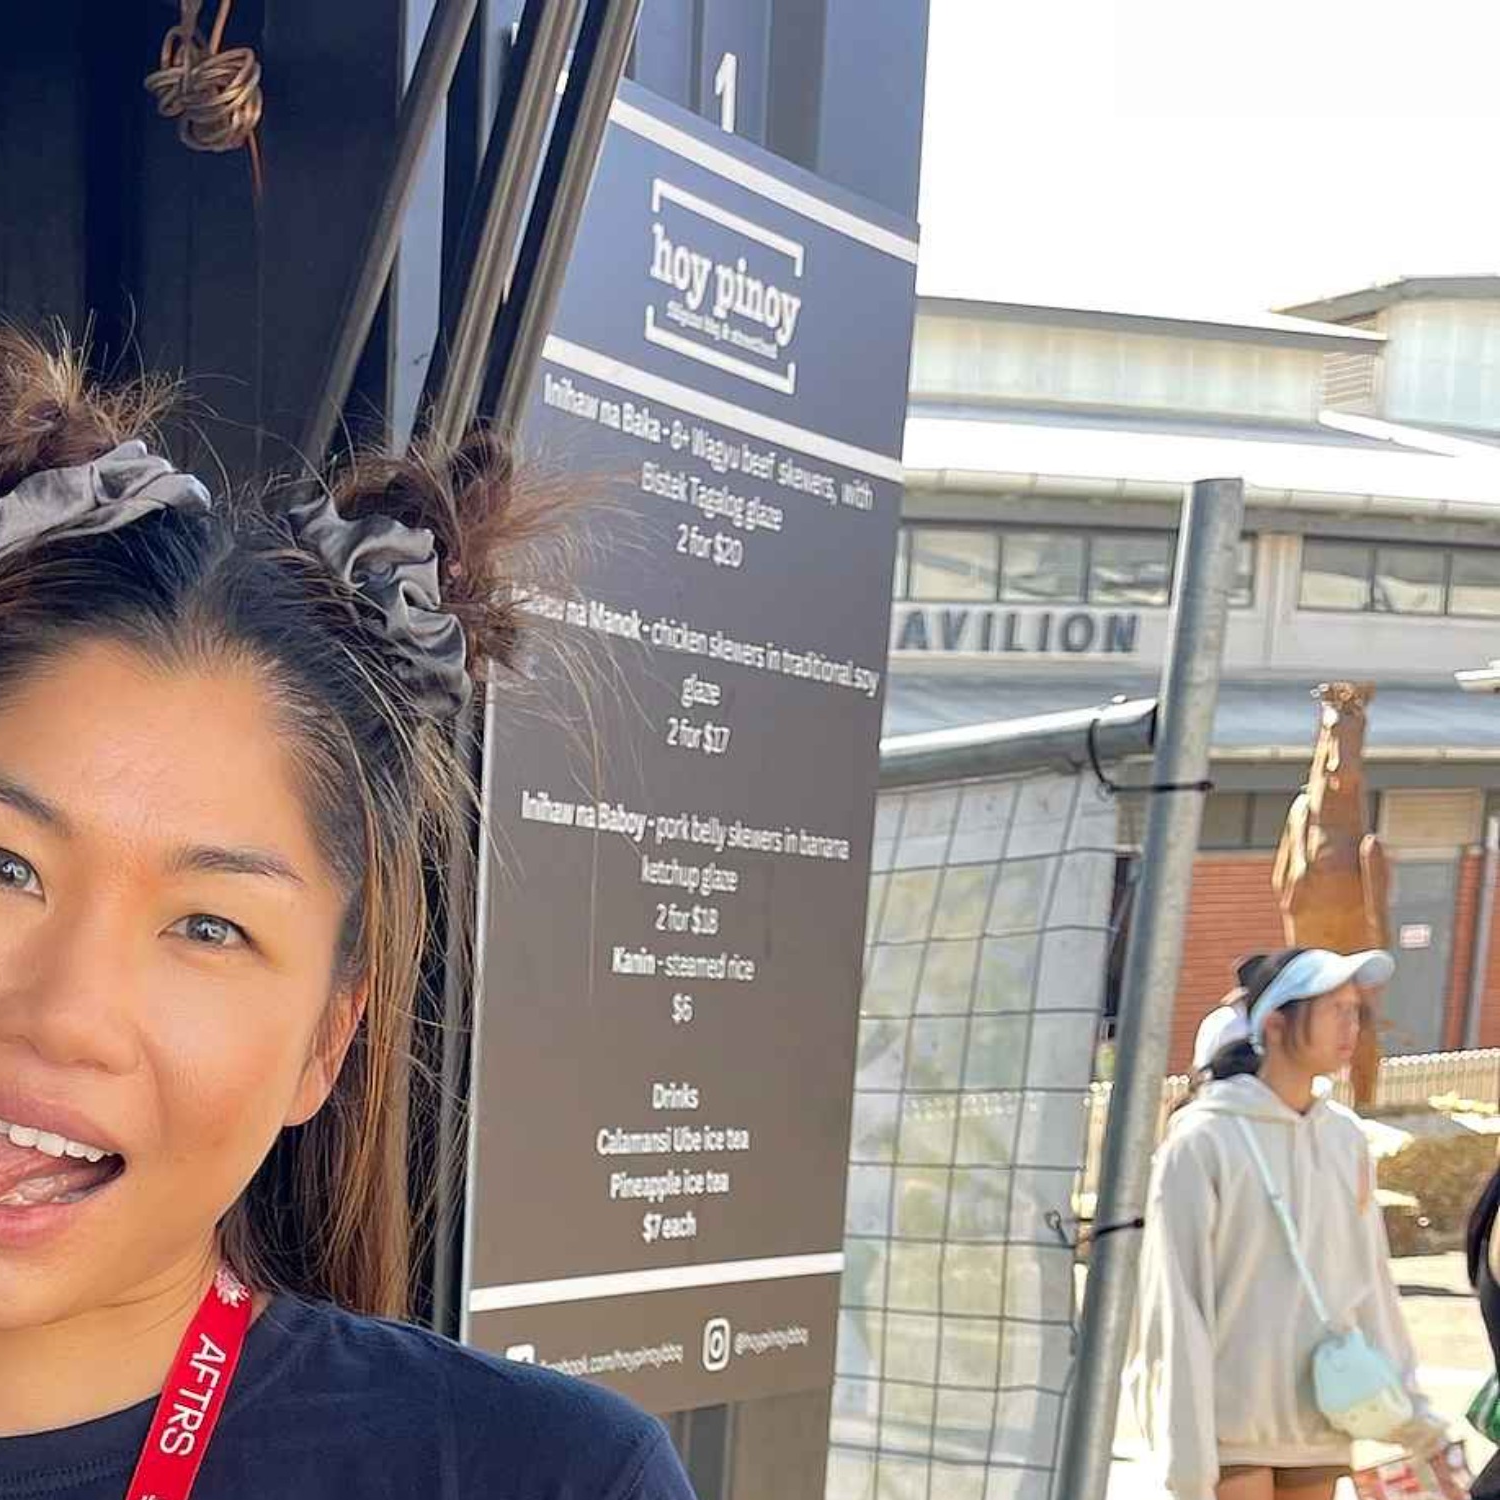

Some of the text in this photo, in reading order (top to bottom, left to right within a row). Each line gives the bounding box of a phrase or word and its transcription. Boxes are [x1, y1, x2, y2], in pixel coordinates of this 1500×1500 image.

[651, 222, 801, 347] hoy pinoy
[544, 372, 598, 420] Inihaw
[599, 401, 621, 430] na
[622, 402, 661, 444] Baka
[691, 428, 740, 473] Wagyu
[741, 443, 776, 481] beef
[777, 457, 838, 506] skewers,
[841, 478, 874, 511] with
[641, 460, 785, 532] Bistek Tagalog glaze
[676, 523, 689, 554] 2
[689, 524, 713, 559] for
[897, 610, 1137, 652] AVILION
[651, 618, 708, 655] chicken
[708, 630, 766, 669] skewers
[766, 642, 781, 671] in
[781, 648, 853, 688] traditional
[853, 666, 880, 698] soy
[681, 672, 721, 708] glaze
[667, 717, 679, 746] 2
[679, 718, 702, 749] for
[521, 790, 575, 825] Inihaw
[575, 803, 597, 829] na
[597, 801, 648, 842] Baboy
[655, 812, 689, 845] pork
[690, 813, 726, 853] belly
[726, 820, 783, 852] skewers
[783, 826, 798, 853] in
[799, 827, 850, 861] banana
[641, 853, 739, 896] ketchup glaze
[655, 902, 668, 931] 2
[668, 902, 690, 932] for
[612, 946, 656, 975] Kanin
[664, 952, 727, 980] steamed
[727, 953, 755, 981] rice
[671, 992, 694, 1024] $6
[652, 1081, 699, 1111] Drinks
[596, 1124, 749, 1156] Calamansi Ube ice tea
[610, 1168, 730, 1203] Pineapple ice tea
[662, 1210, 697, 1240] each
[158, 1332, 227, 1457] AFTRS
